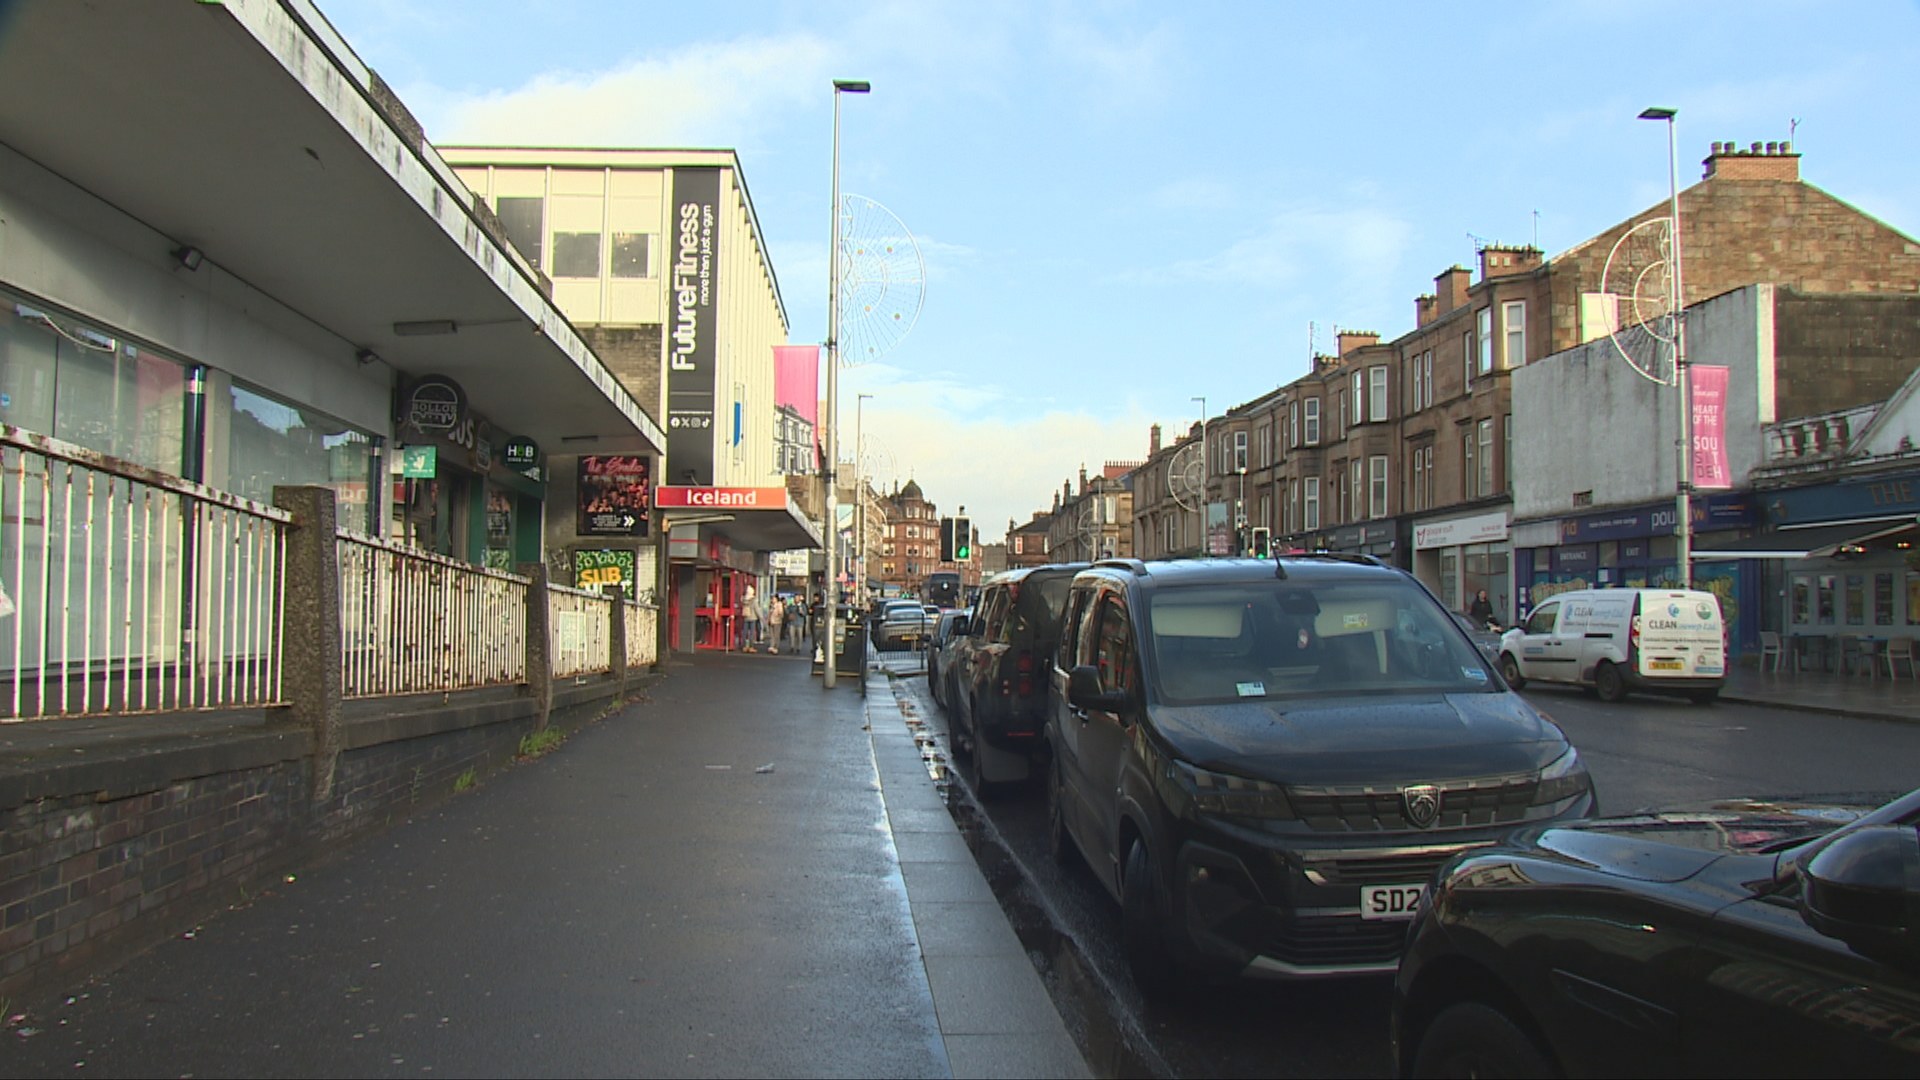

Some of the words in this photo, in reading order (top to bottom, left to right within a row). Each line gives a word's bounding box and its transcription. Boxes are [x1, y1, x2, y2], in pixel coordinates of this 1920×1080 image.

[703, 205, 713, 227] gym
[700, 237, 712, 255] just
[700, 255, 709, 278] than
[671, 203, 699, 371] FutureFitness
[701, 279, 709, 305] more
[1693, 405, 1718, 415] HEART
[1693, 415, 1703, 425] OF
[1704, 415, 1717, 425] THE
[687, 489, 757, 504] Iceland
[1866, 481, 1912, 505] THE
[1560, 551, 1586, 561] ENTRANCE
[1626, 547, 1640, 556] EXIT
[580, 566, 621, 584] SUB
[1649, 620, 1677, 630] CLEAN
